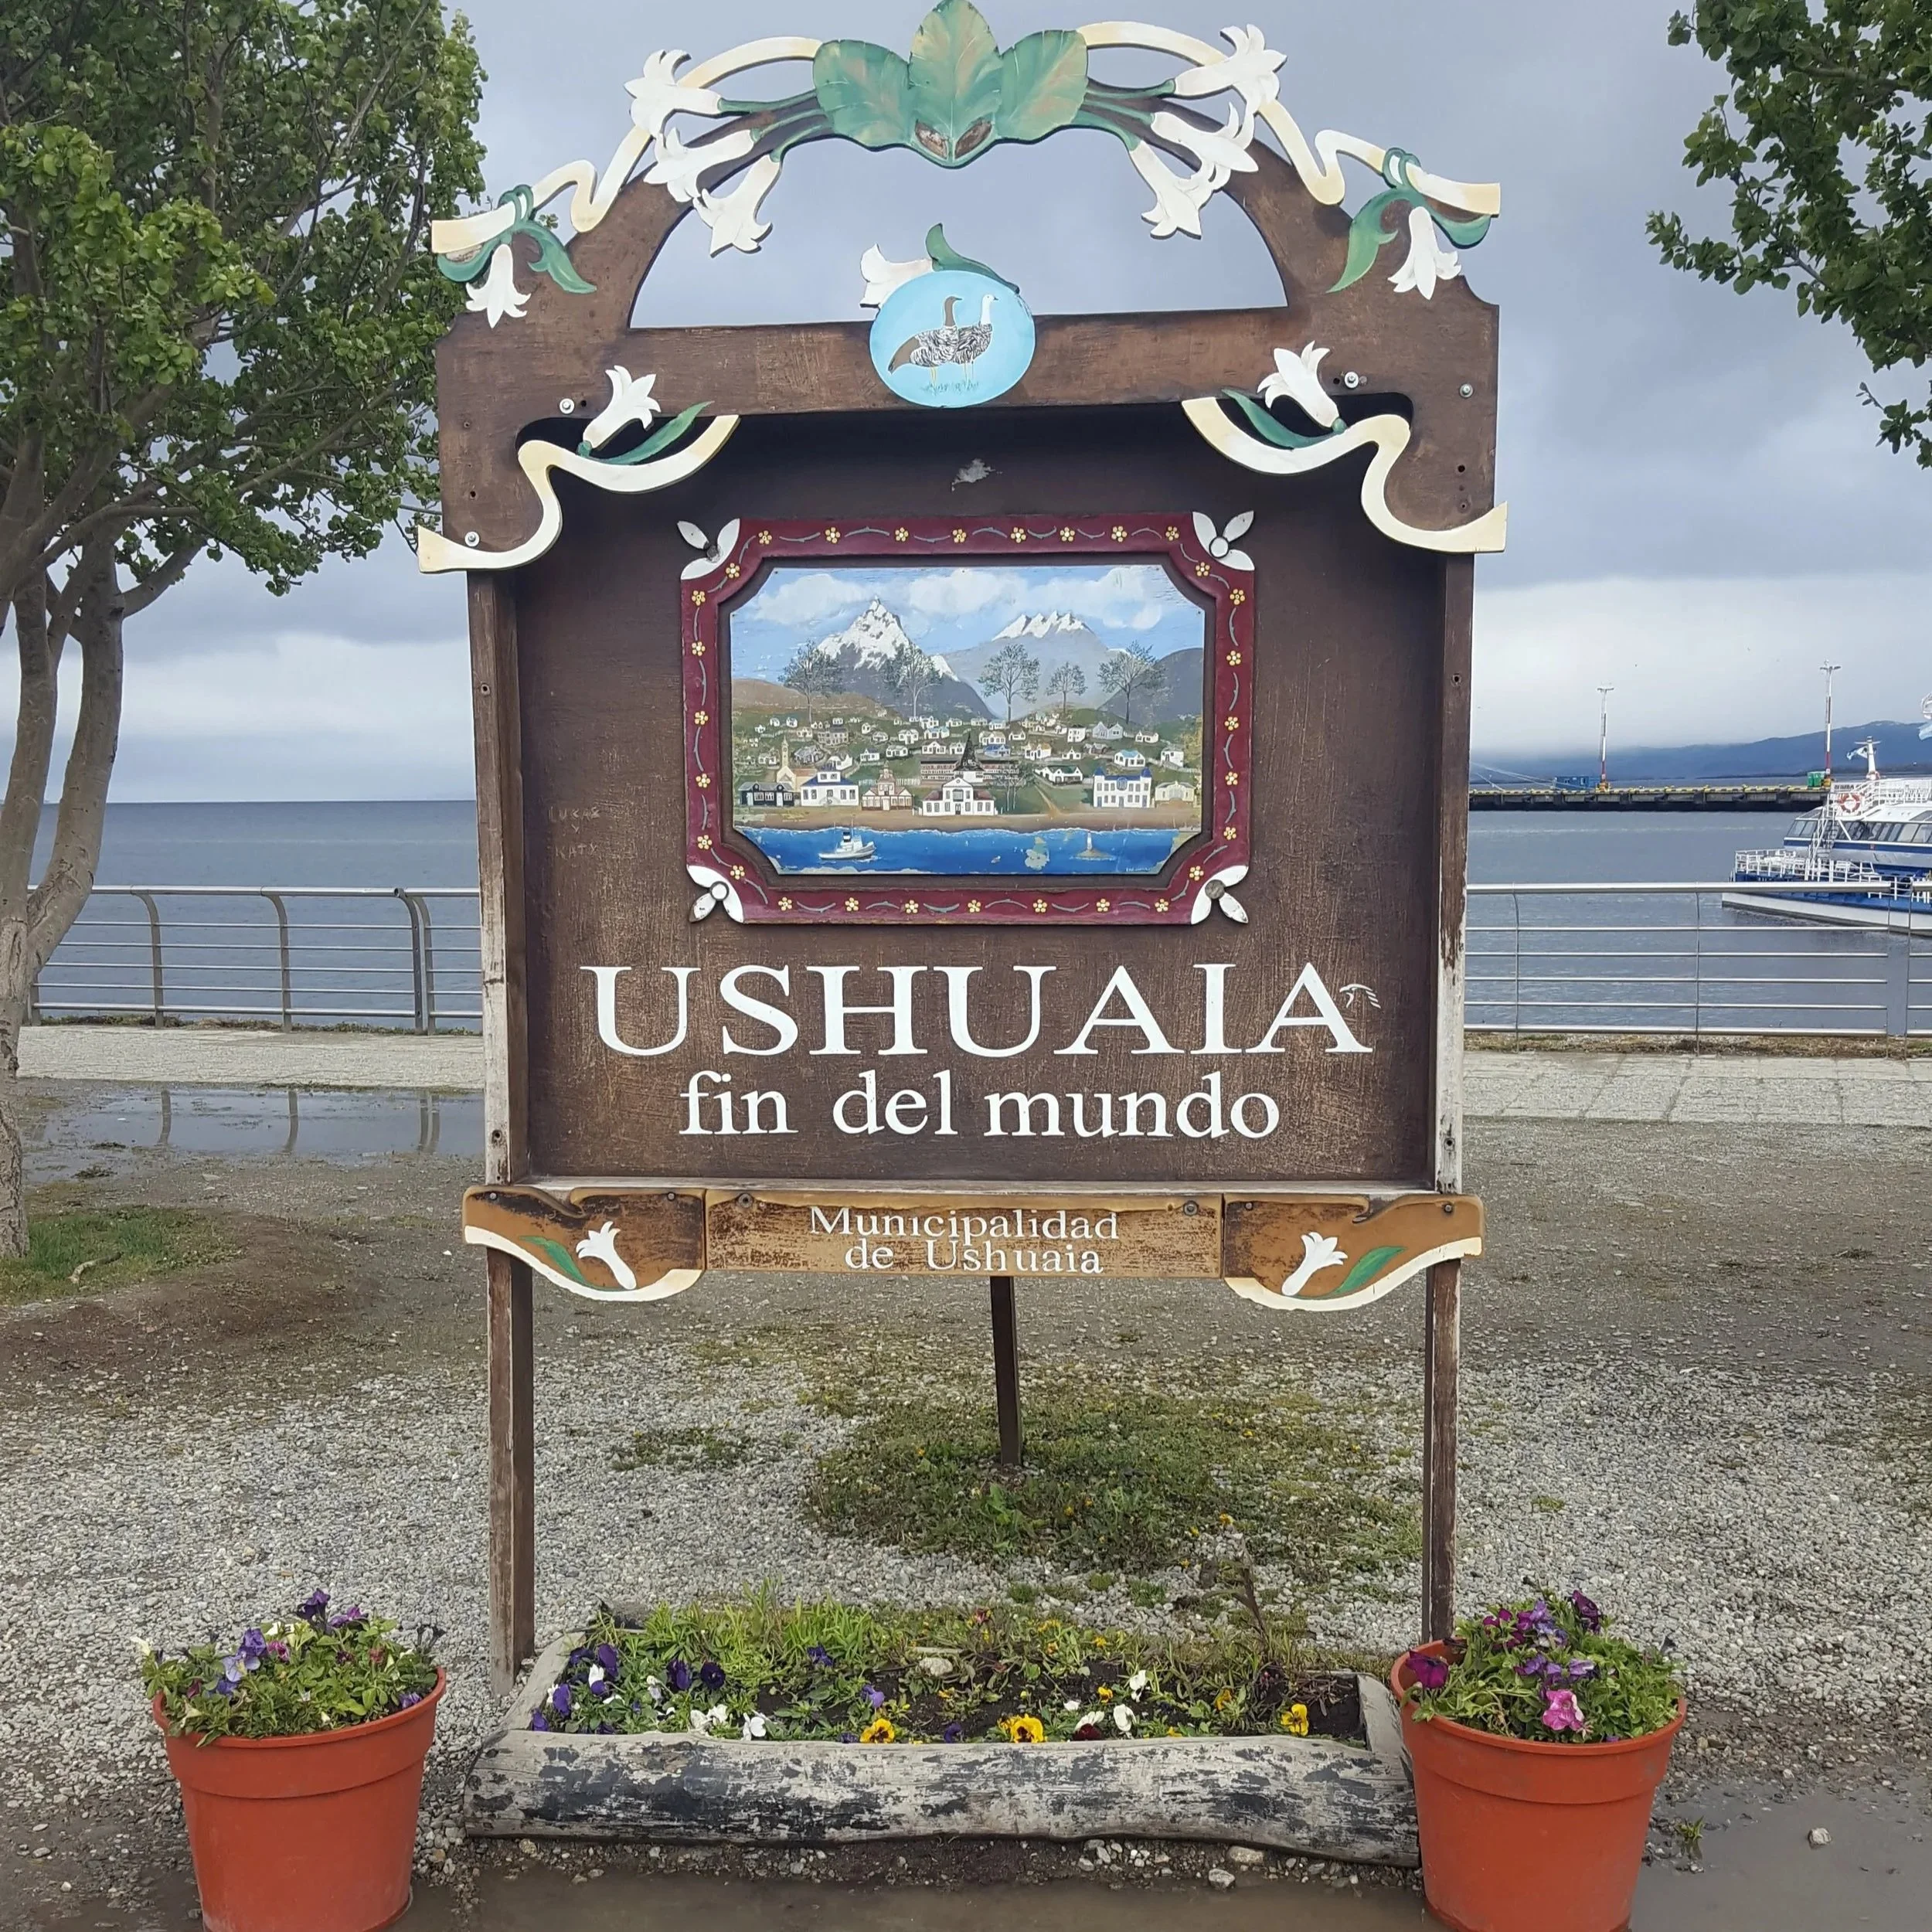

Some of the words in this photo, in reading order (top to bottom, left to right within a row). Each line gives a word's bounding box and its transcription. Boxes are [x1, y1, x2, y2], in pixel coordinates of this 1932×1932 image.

[580, 962, 1373, 1057] USHUAIA
[679, 1070, 799, 1135] fin
[833, 1069, 958, 1135] del
[984, 1070, 1280, 1139] mundo
[811, 1207, 1119, 1246] Municipalidad
[845, 1238, 893, 1270] de
[925, 1239, 1104, 1274] Ushuaia
